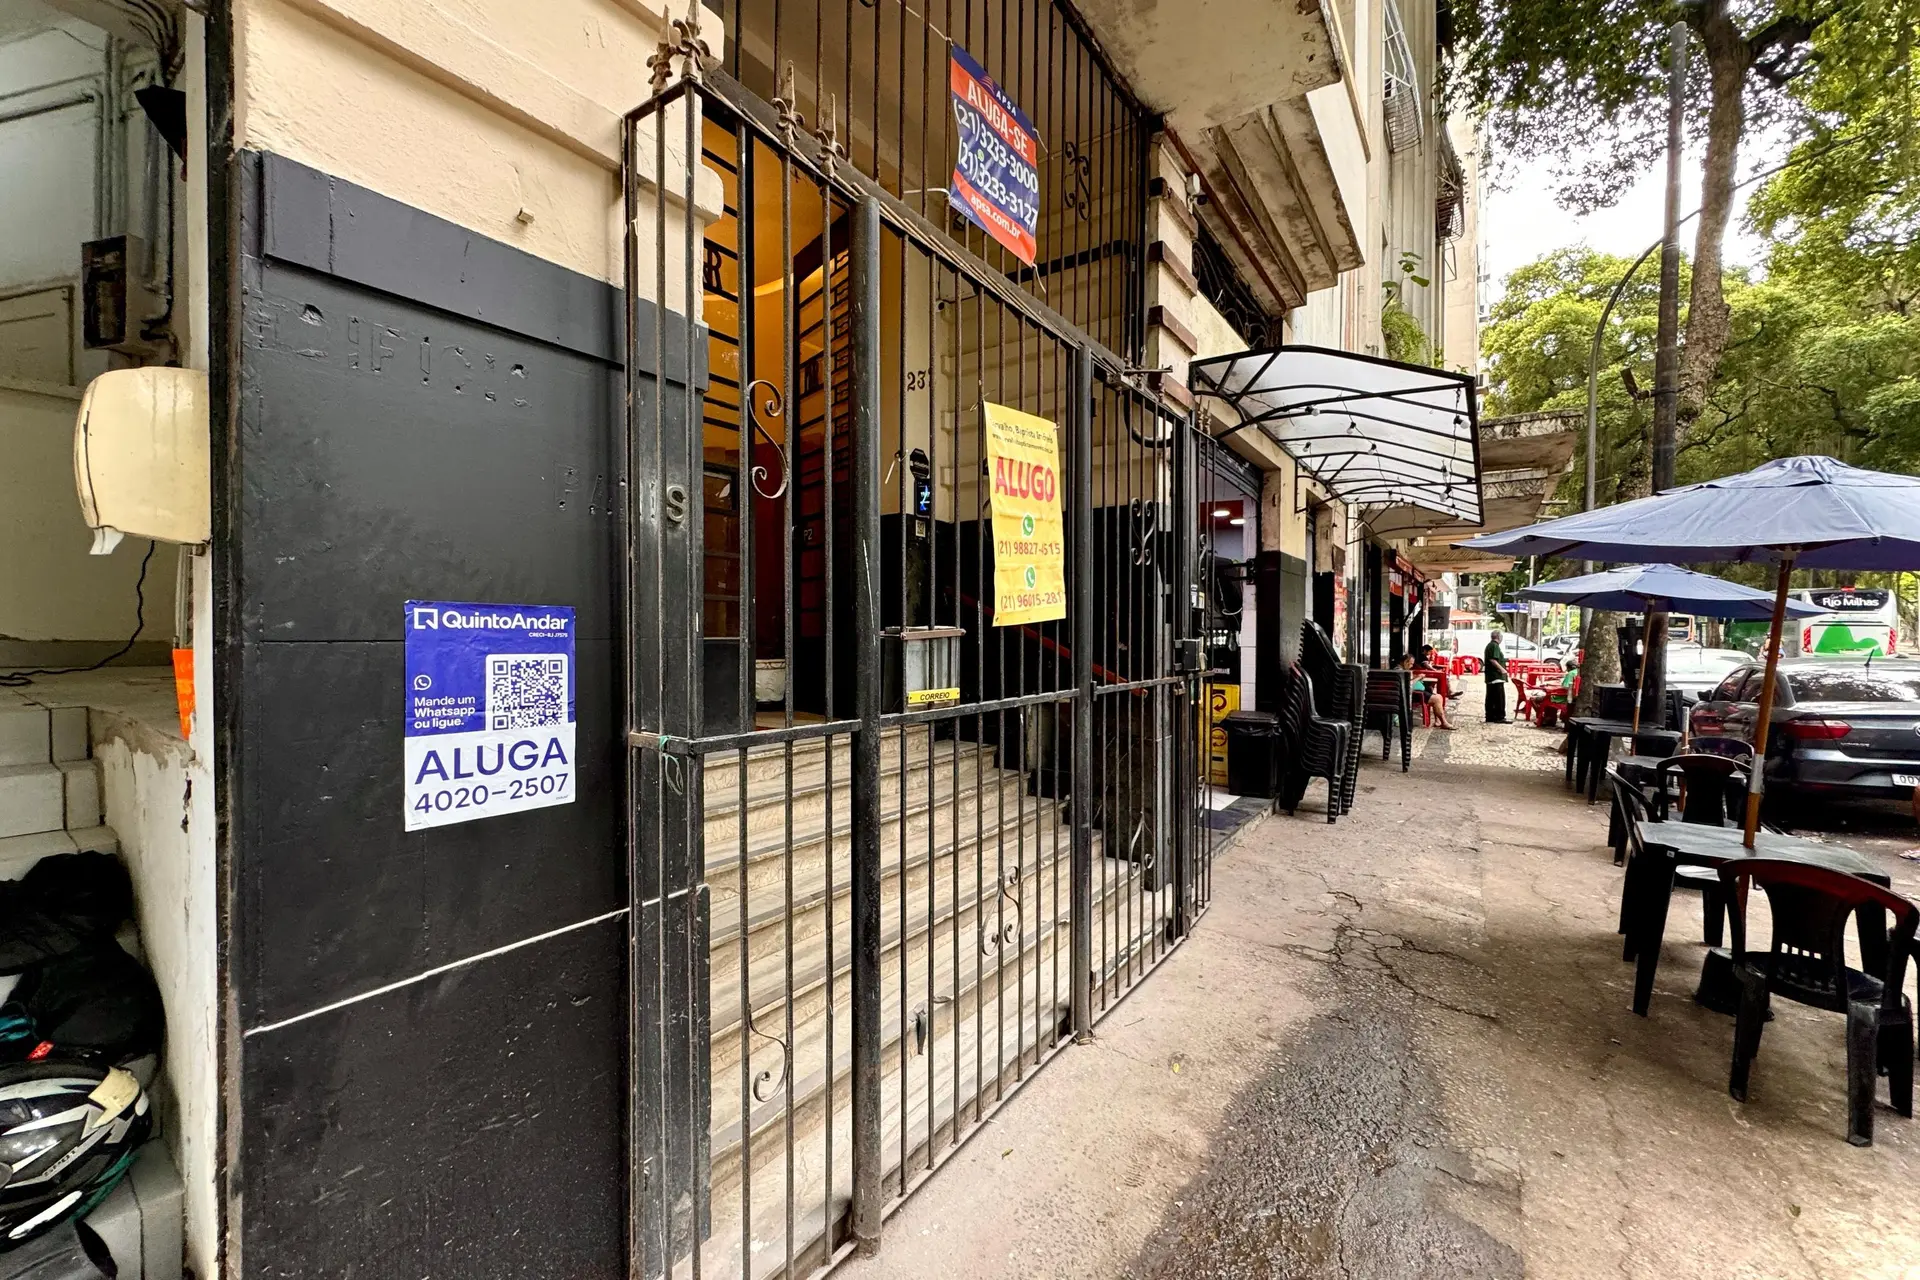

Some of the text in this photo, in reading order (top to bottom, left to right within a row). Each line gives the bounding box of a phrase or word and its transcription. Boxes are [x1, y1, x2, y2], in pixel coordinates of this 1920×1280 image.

[996, 90, 1016, 116] APSA
[968, 79, 1028, 158] ALUGA-SE
[970, 194, 1022, 239] apsa.com.br
[907, 370, 932, 391] 23
[994, 456, 1056, 503] ALUGO
[998, 541, 1012, 557] (21)
[1001, 595, 1015, 611] (21)
[1822, 597, 1880, 607] Rio Milhas
[442, 611, 568, 630] QuintoAndar
[414, 695, 475, 707] Mande um
[919, 692, 950, 701] CORREIO
[414, 705, 476, 717] Whatsapp
[414, 717, 465, 729] ou ligue.
[414, 737, 568, 785] ALUGA
[414, 773, 569, 814] 4020-2507
